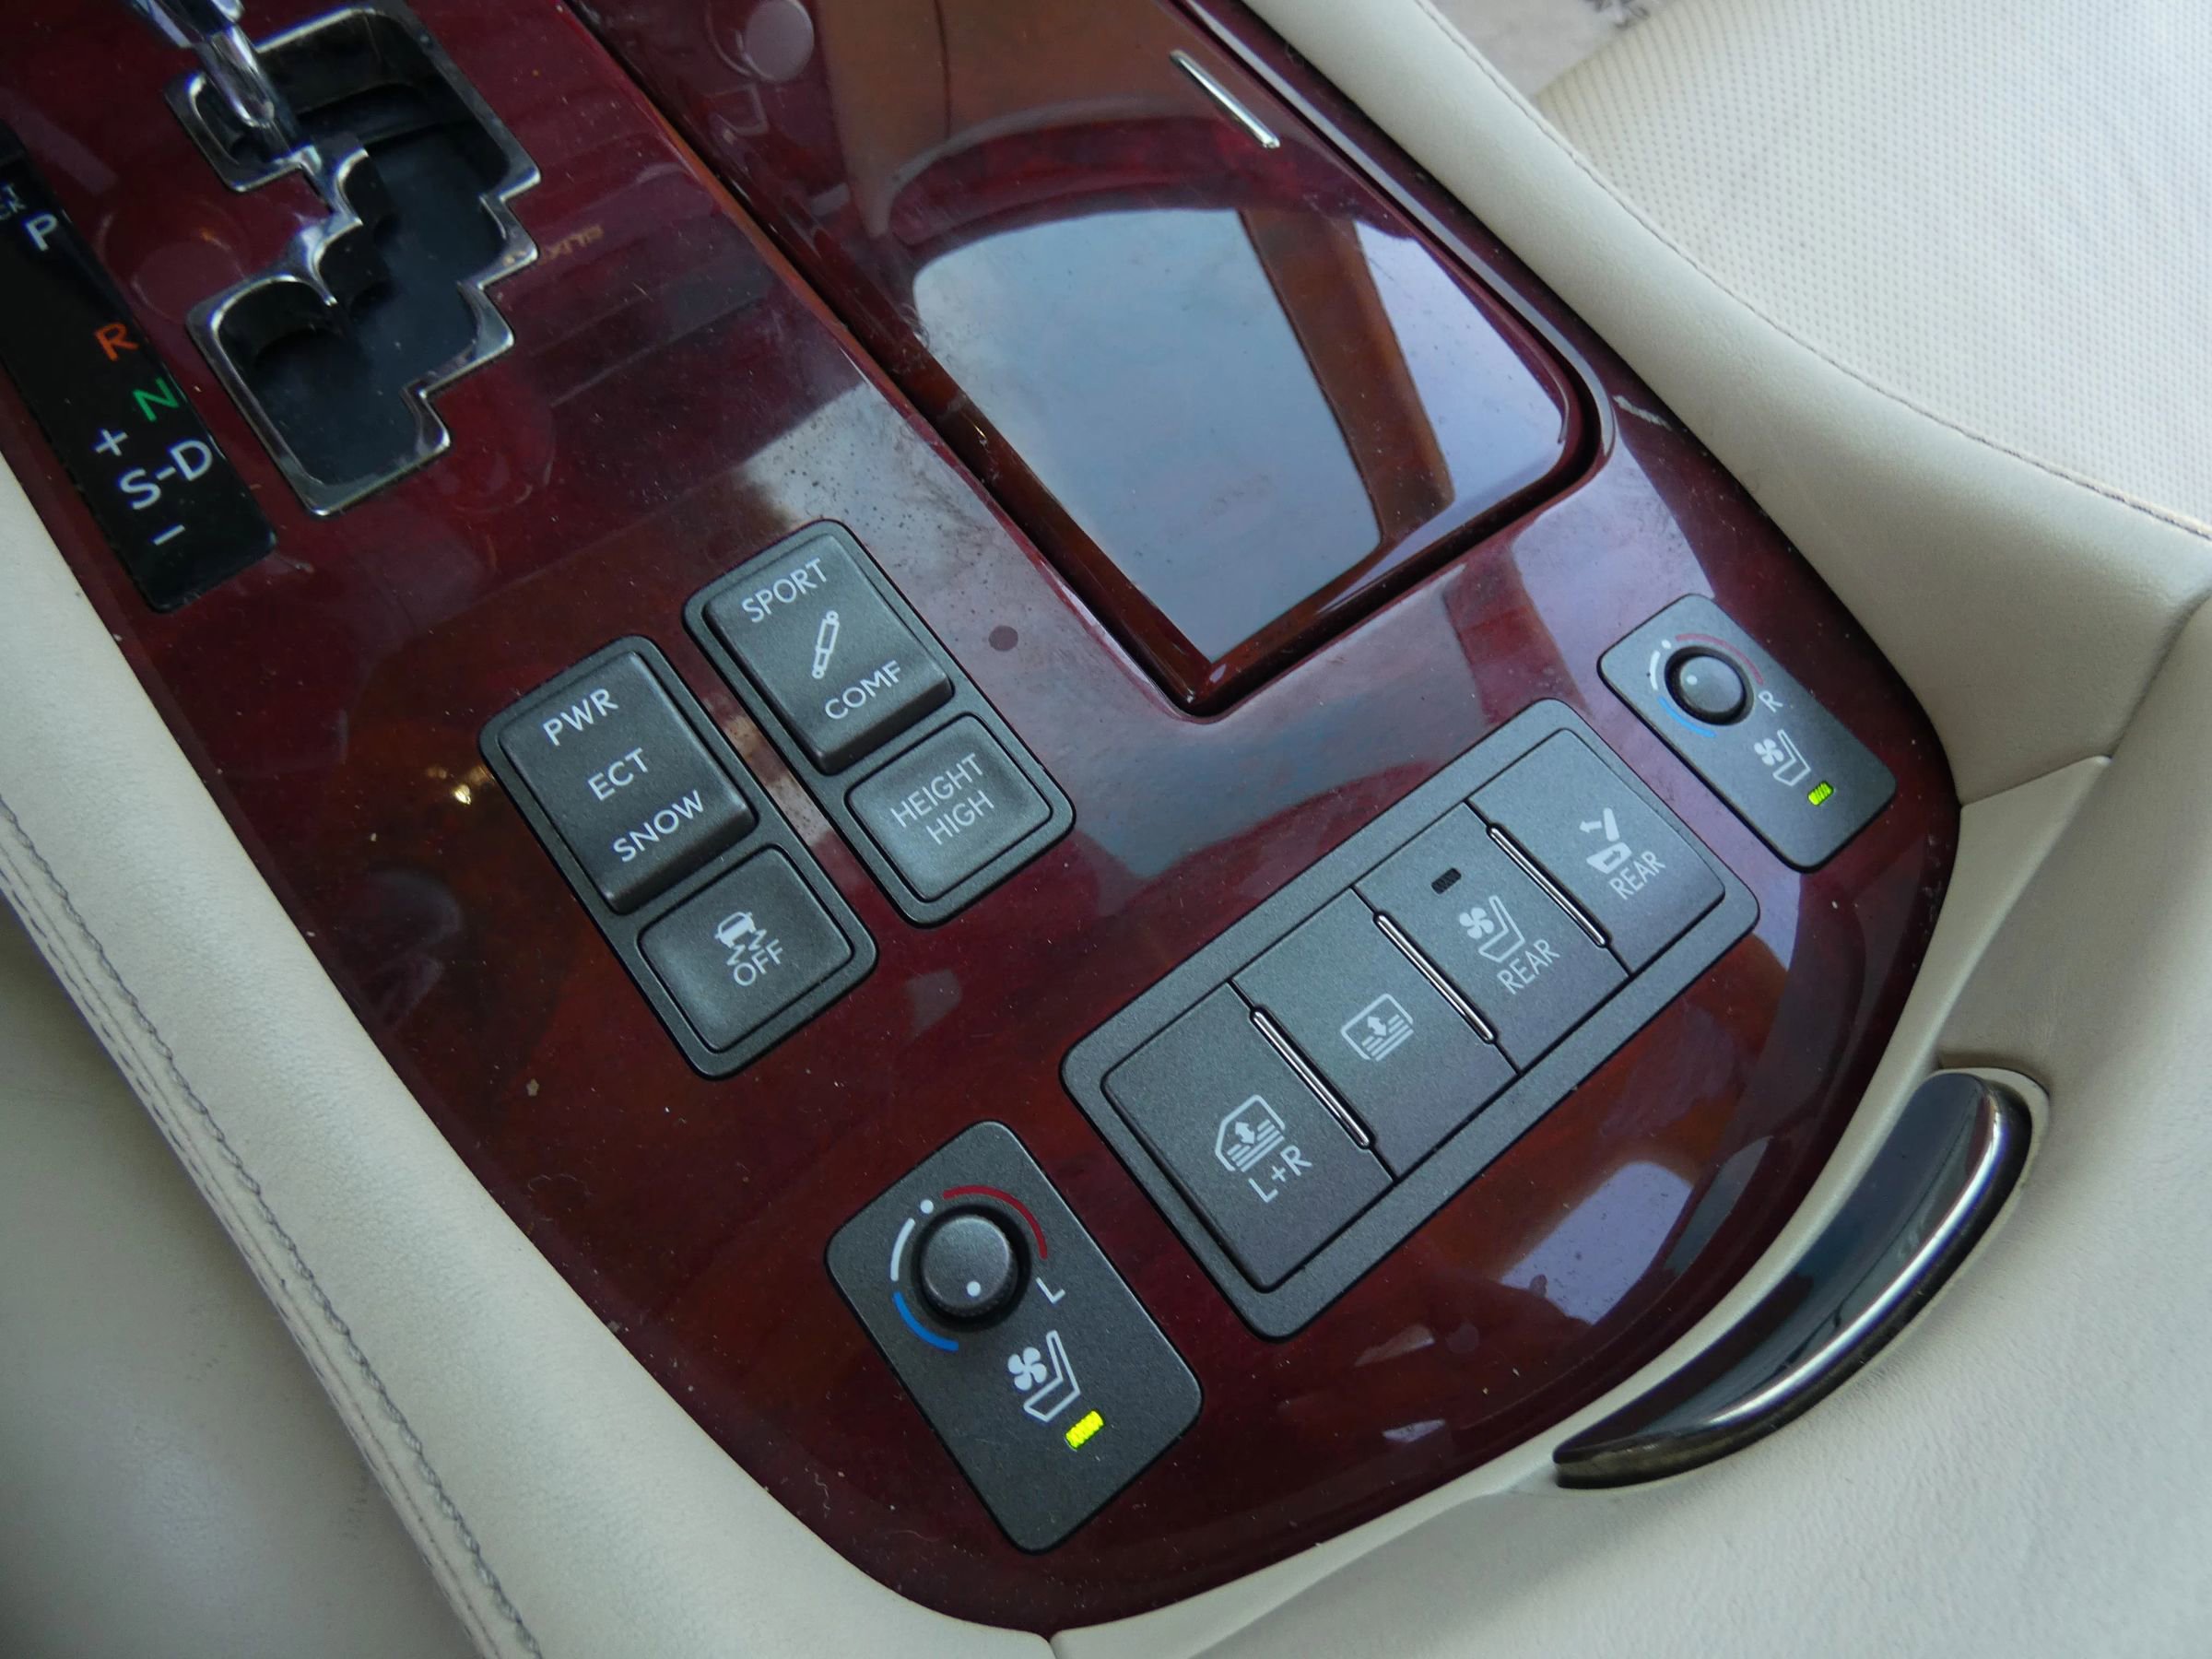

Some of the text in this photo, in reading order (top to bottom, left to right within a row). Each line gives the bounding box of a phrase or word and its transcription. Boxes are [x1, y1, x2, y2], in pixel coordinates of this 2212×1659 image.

[24, 213, 57, 251] P
[95, 324, 139, 361] R
[133, 377, 179, 421] N
[741, 558, 827, 623] SPORT
[543, 688, 619, 746] PWR
[825, 660, 900, 719] COMF
[1758, 689, 1783, 713] R
[588, 747, 648, 801] ECT
[889, 752, 982, 828] HEIGHT
[613, 789, 704, 862] SNOW
[925, 789, 994, 845] HIGH
[1608, 851, 1666, 900] REAR
[734, 938, 783, 986] OFF
[1497, 939, 1560, 995] REAR
[1248, 1145, 1312, 1203] L+R
[1036, 1277, 1065, 1304] L
